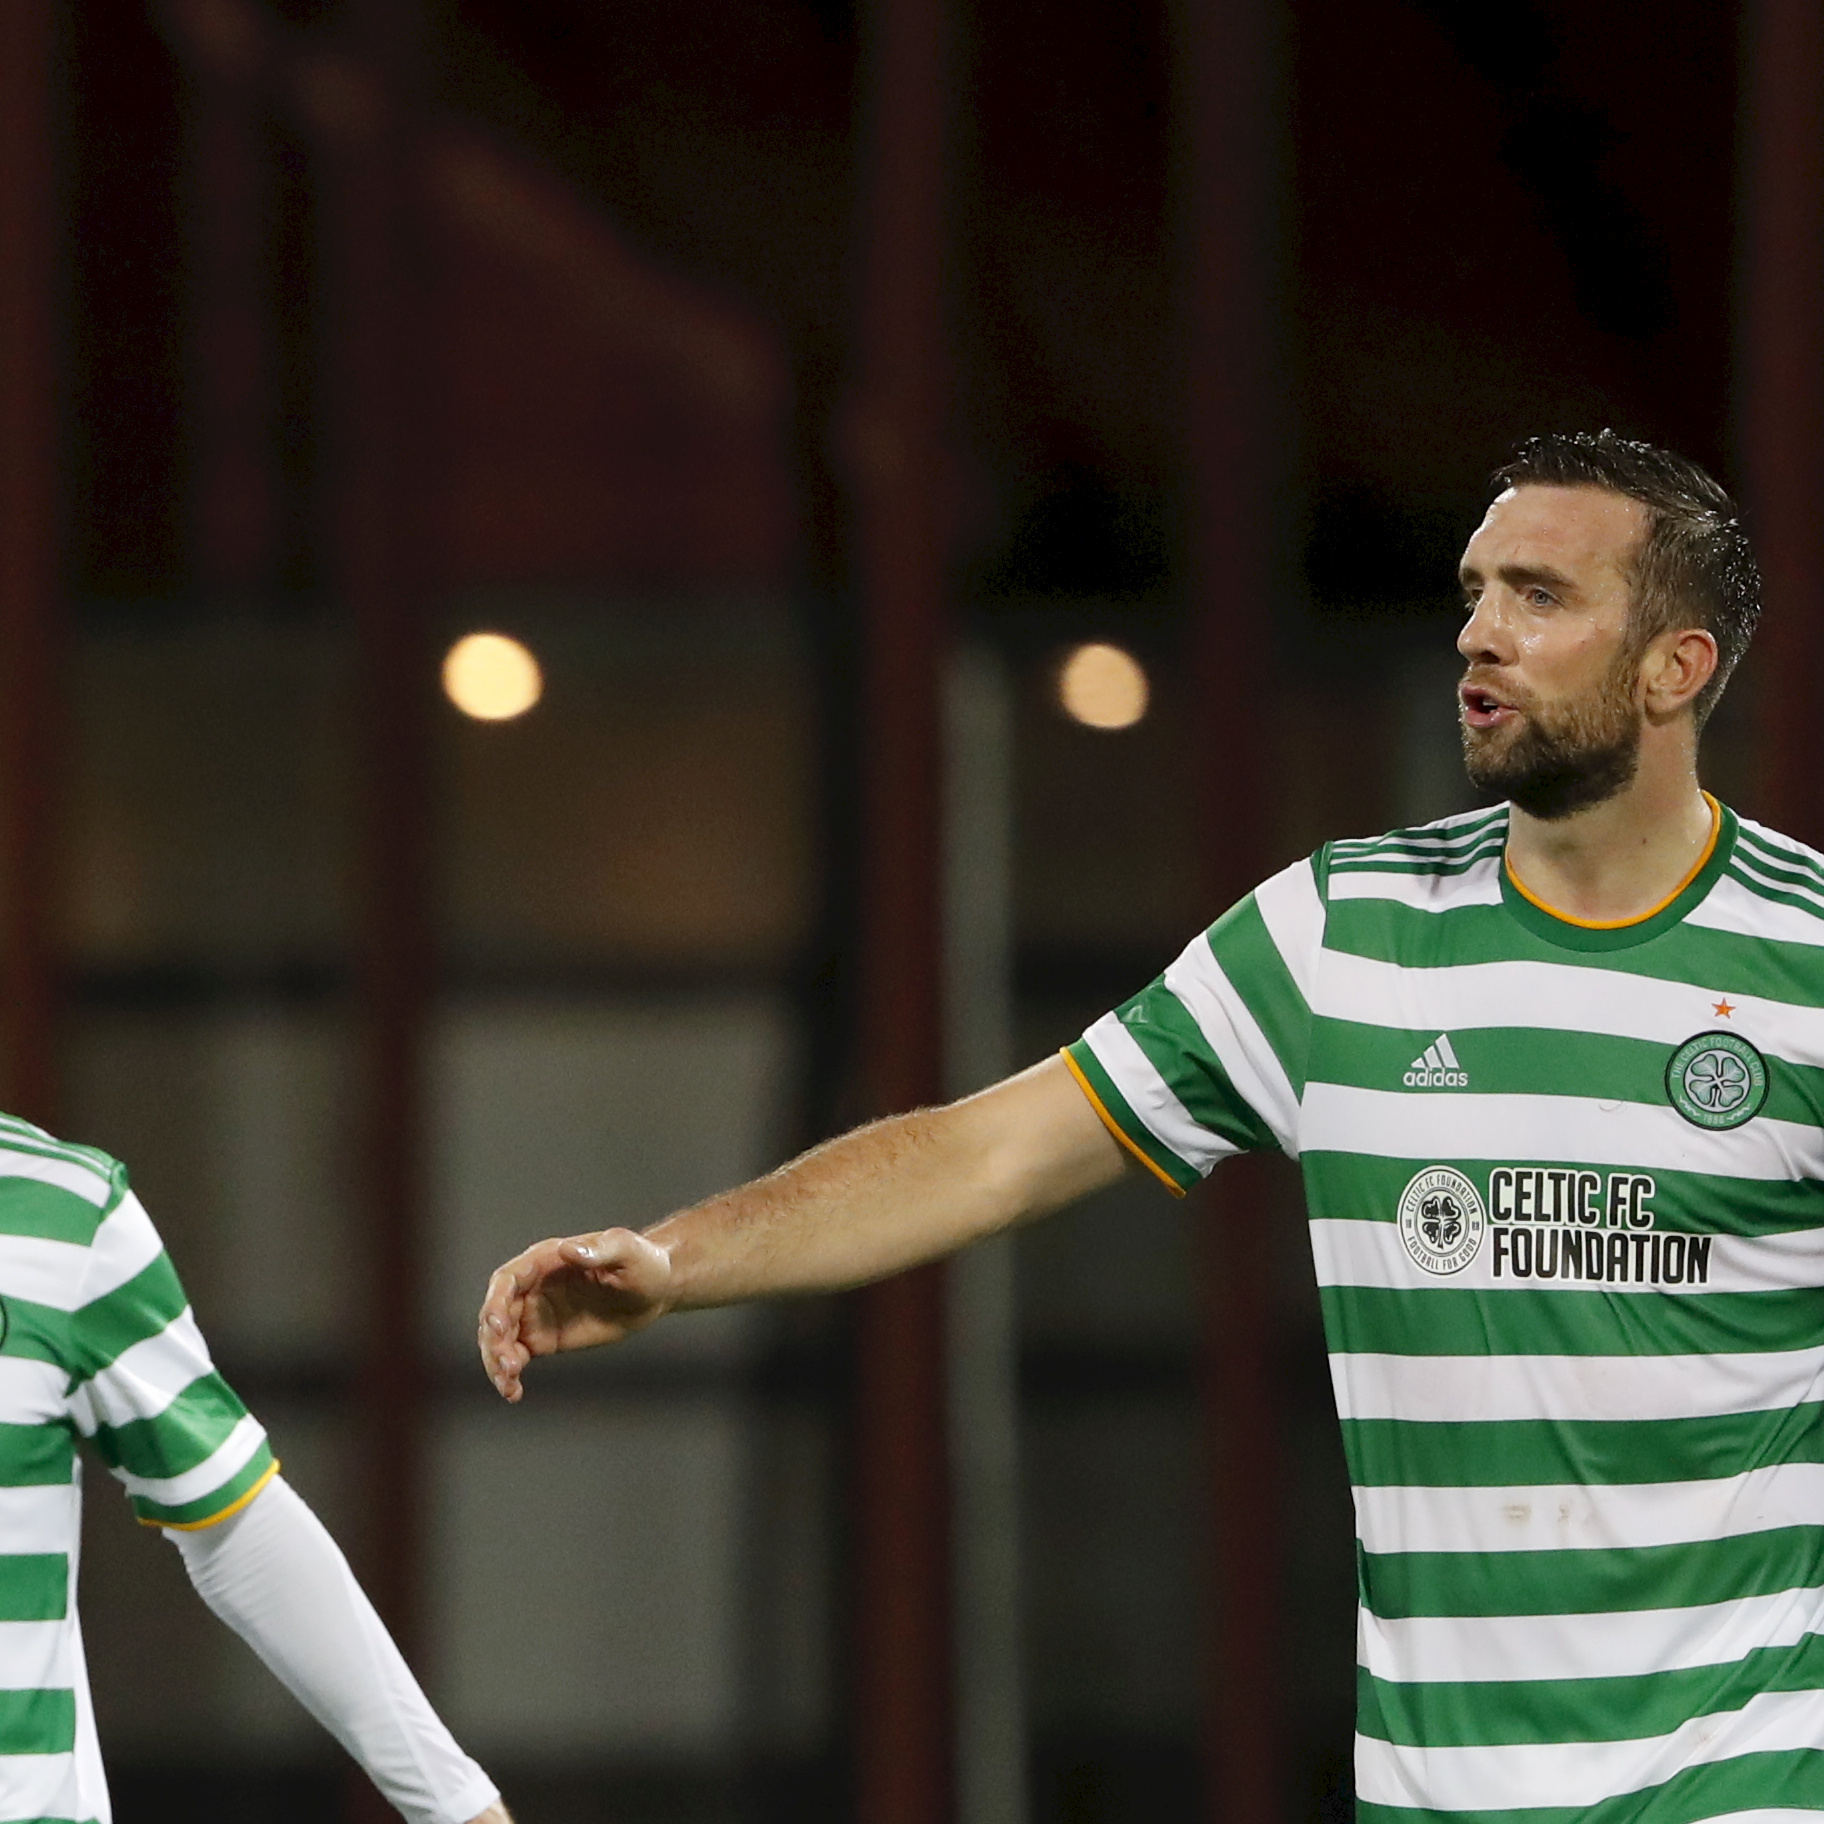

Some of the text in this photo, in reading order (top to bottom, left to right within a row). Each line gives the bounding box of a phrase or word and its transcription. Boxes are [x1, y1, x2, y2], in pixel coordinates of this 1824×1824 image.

[1402, 1067, 1468, 1088] adidas
[1406, 1182, 1426, 1213] CELTIC
[1492, 1171, 1653, 1228] CELTIC FC
[1493, 1229, 1711, 1284] FOUNDATION
